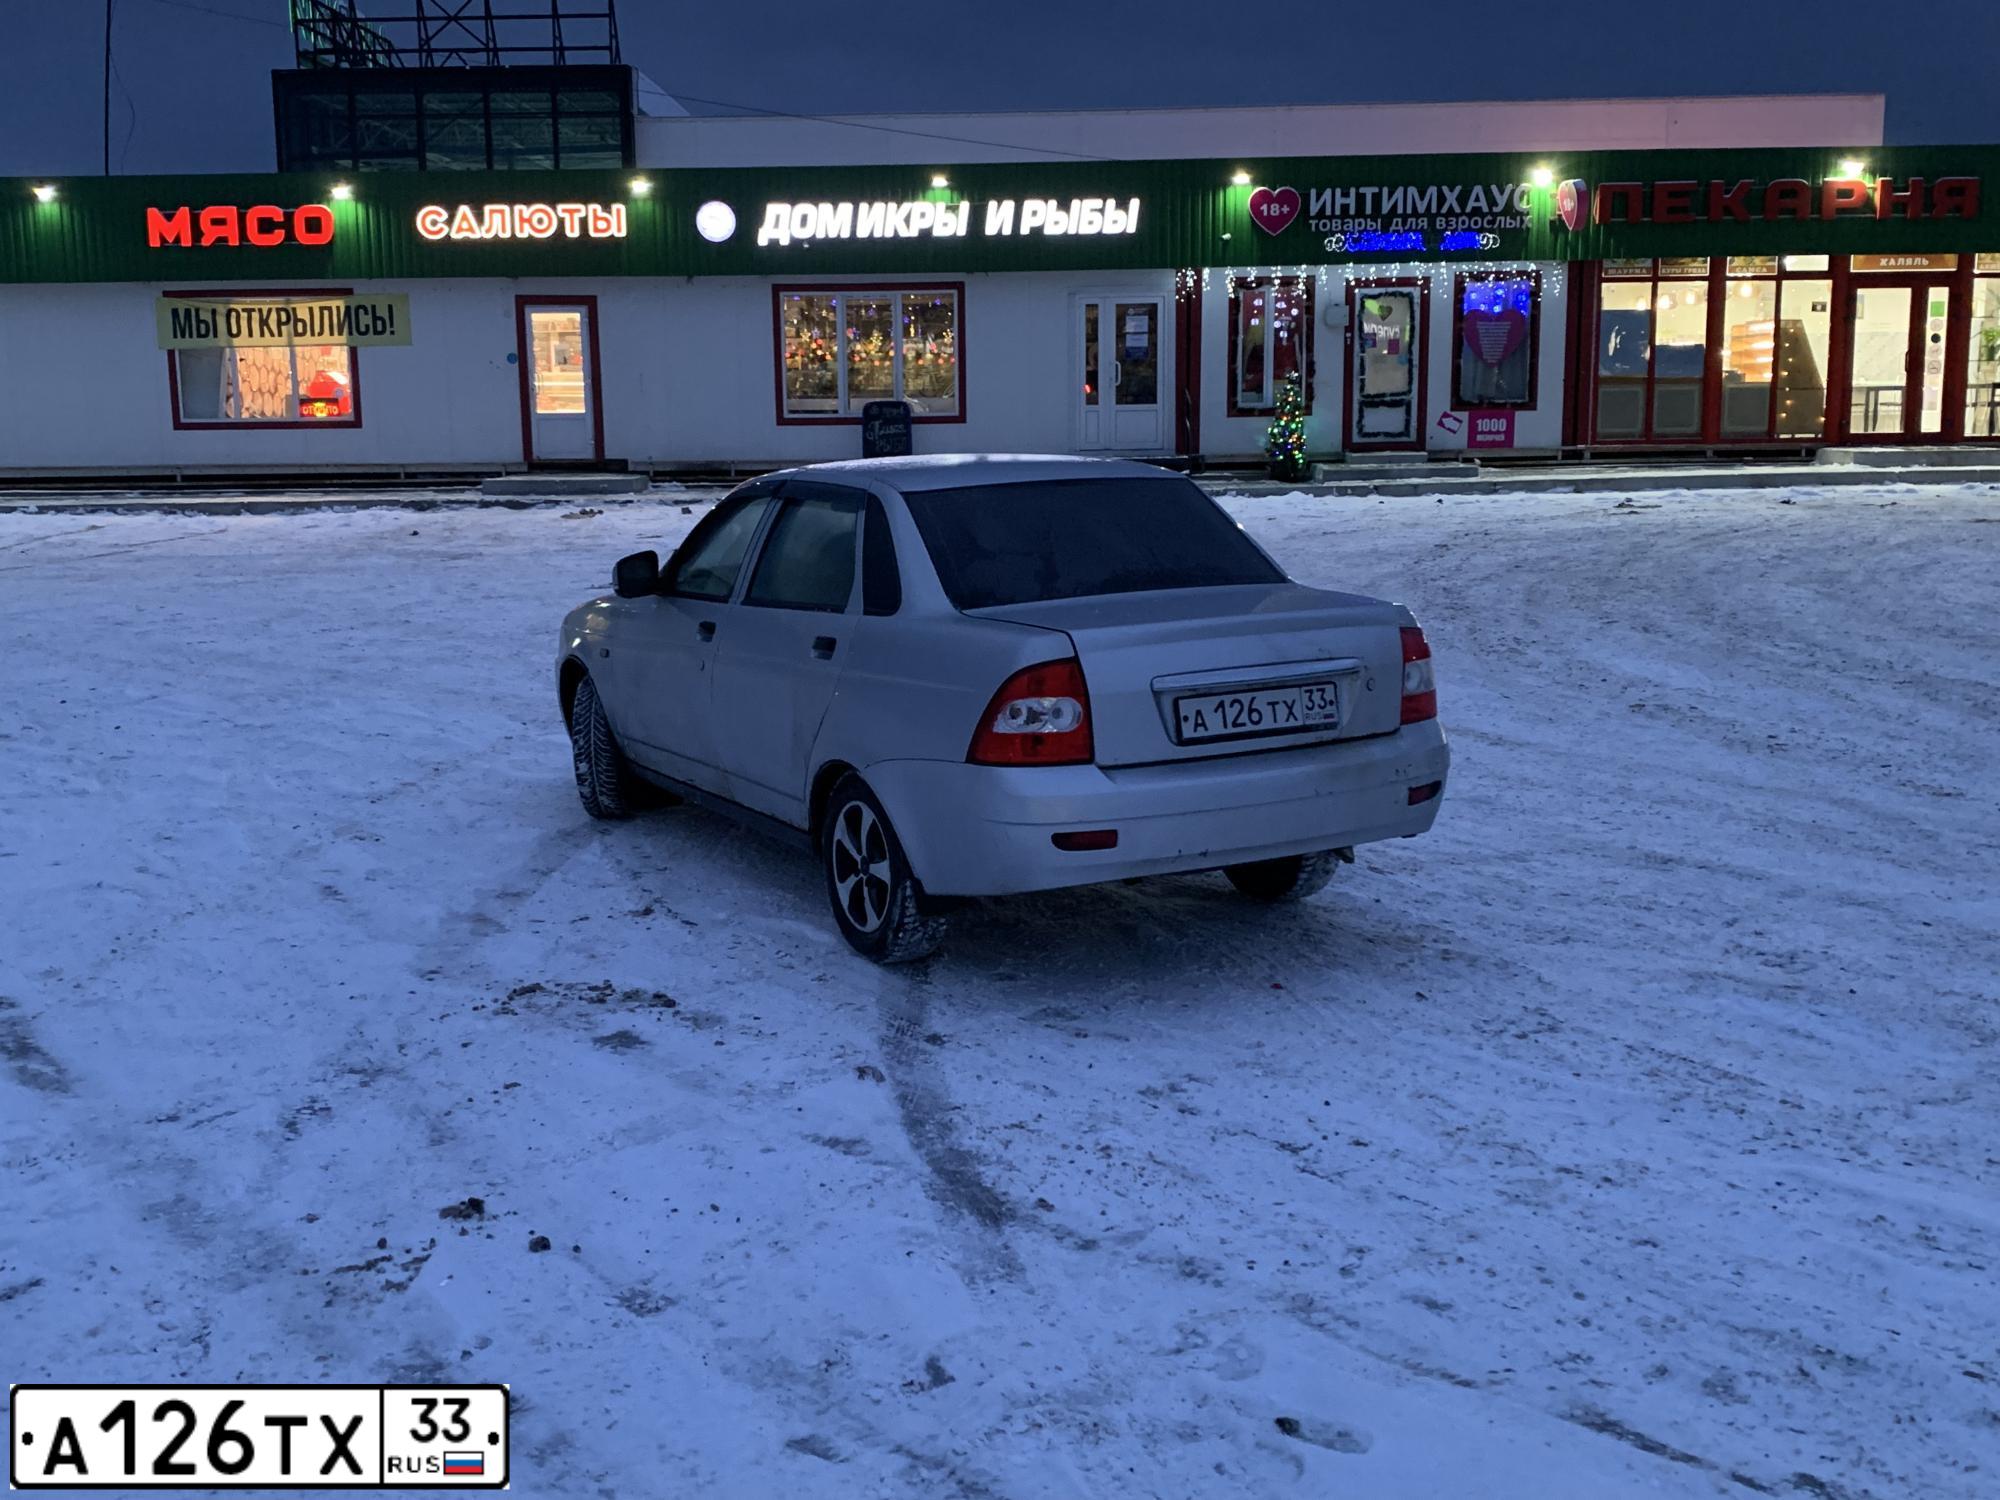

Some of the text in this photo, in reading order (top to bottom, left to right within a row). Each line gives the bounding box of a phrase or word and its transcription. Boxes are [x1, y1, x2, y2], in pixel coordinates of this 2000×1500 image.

[1259, 202, 1290, 217] 18+
[1309, 183, 1532, 216] ИНТИМХАУС
[1595, 177, 1981, 224] ПЕКАРНЯ
[147, 204, 335, 248] МЯСО
[416, 202, 628, 240] САЛЮТЫ
[757, 197, 1141, 247] ДОМ ИКРЫ И РЫБЫ
[1309, 214, 1532, 233] товары для взрослых
[1879, 257, 1929, 267] ХАЛЯЛЬ
[171, 303, 396, 340] МЫ ОТКРЫЛИСЬ!
[1475, 418, 1507, 432] 1000
[1304, 687, 1328, 711] 33
